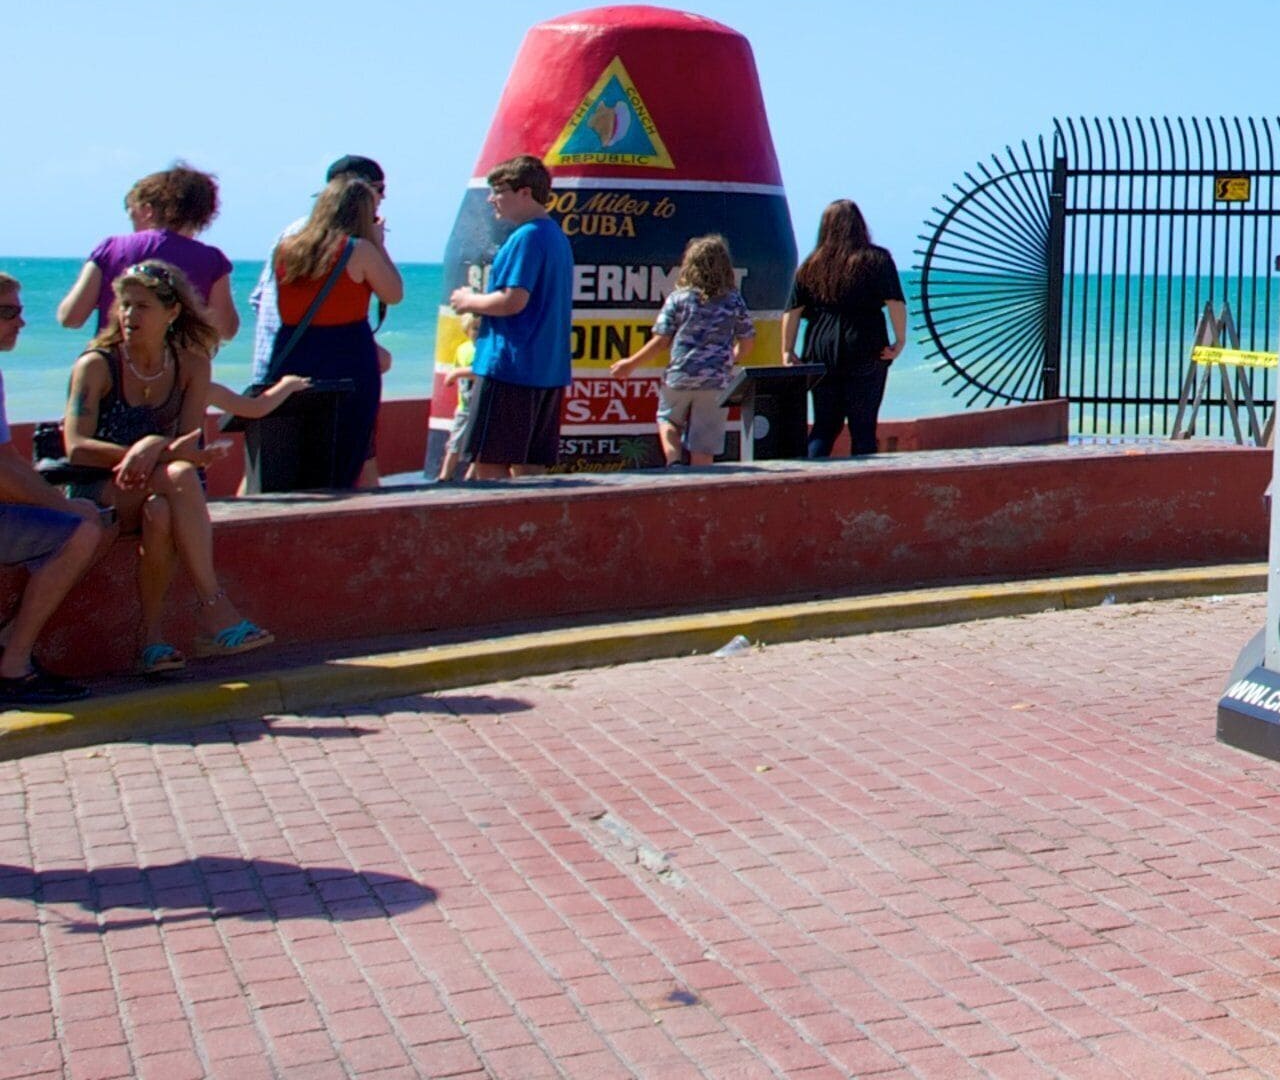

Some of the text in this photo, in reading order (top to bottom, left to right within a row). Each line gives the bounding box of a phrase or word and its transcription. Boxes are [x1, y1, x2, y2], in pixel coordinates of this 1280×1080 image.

[560, 87, 657, 165] THE CONCH REPUBLIC
[574, 192, 649, 216] Miles
[653, 197, 677, 219] to
[562, 213, 637, 238] CUBA
[571, 325, 651, 360] OIN
[565, 400, 636, 421] S.A.
